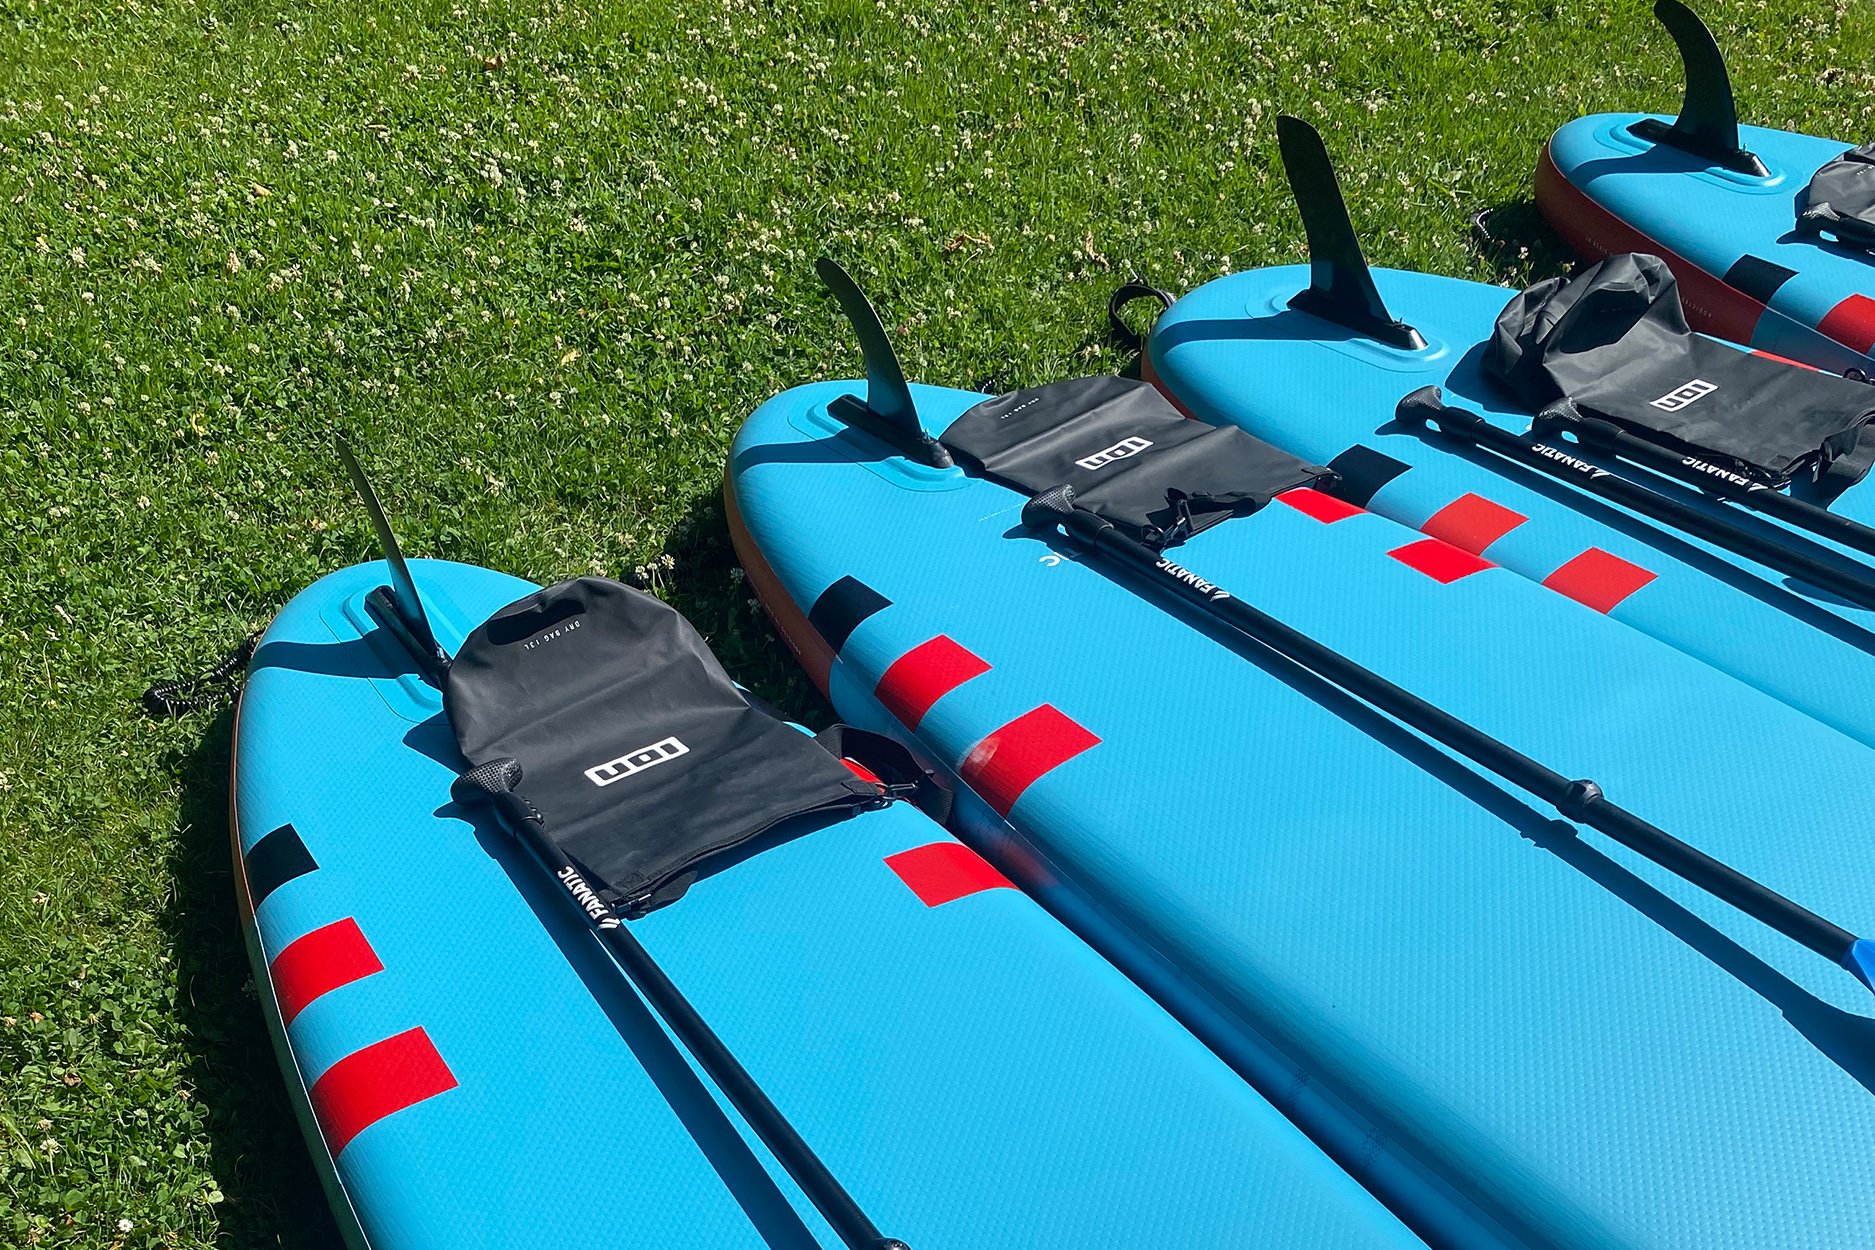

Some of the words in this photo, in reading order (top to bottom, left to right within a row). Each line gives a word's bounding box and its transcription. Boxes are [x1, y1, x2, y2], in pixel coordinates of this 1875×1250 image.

[1531, 443, 1595, 473] FANATIC
[1681, 456, 1750, 487] FANATIC
[1155, 558, 1217, 594] FANATIC
[543, 629, 561, 642] BAG
[564, 620, 581, 633] DRY
[523, 639, 540, 650] 13L
[557, 865, 609, 922] FANATIC
